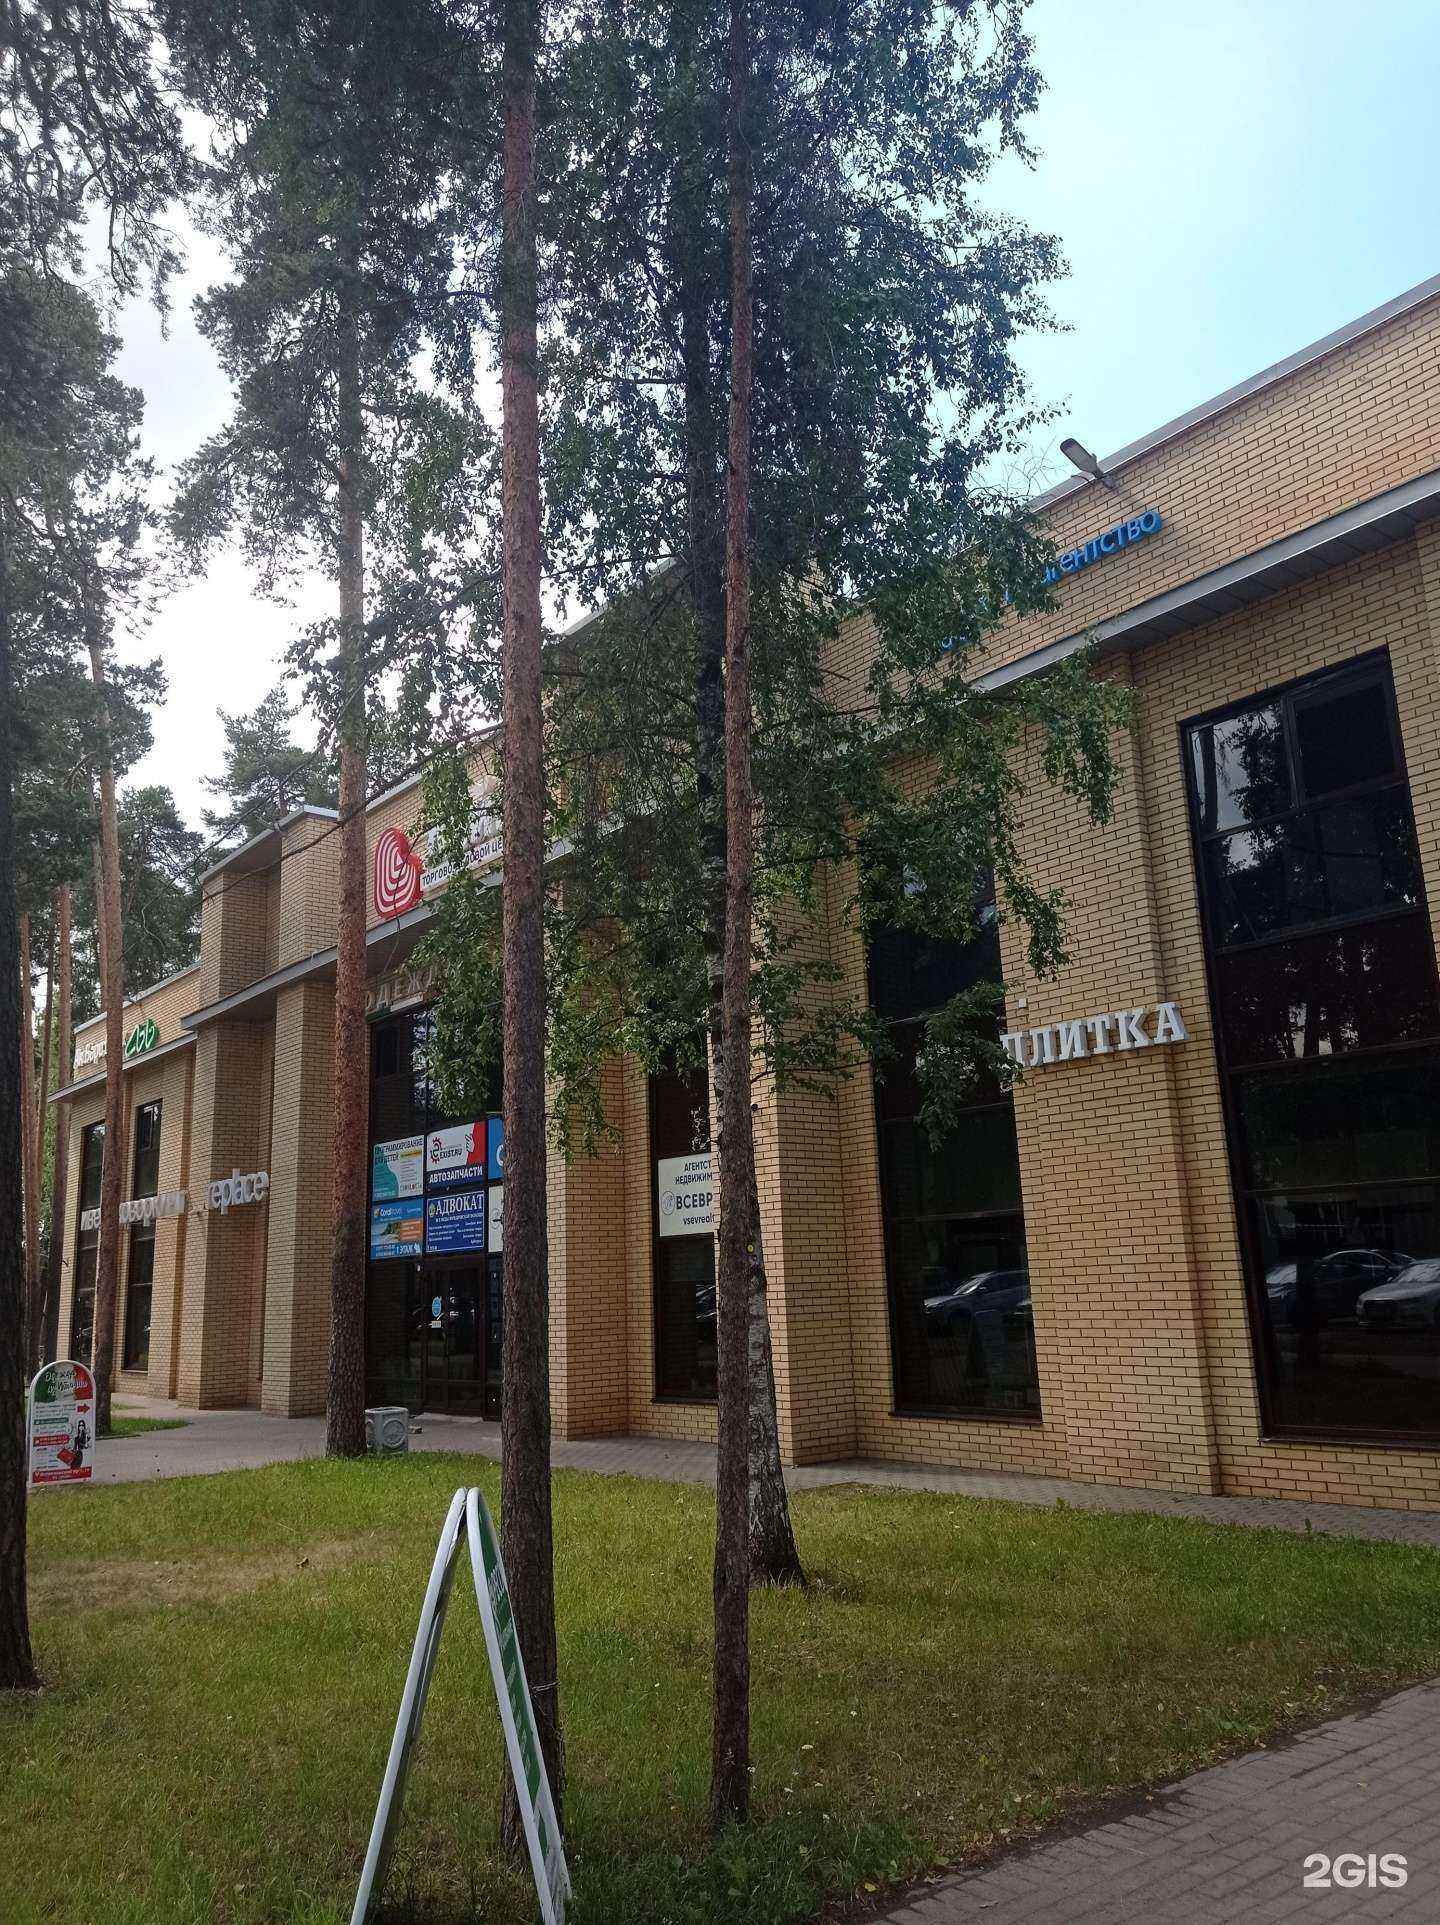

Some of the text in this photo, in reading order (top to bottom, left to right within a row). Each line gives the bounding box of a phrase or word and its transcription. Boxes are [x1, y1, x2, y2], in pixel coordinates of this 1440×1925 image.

[1000, 1002, 1188, 1067] ПЛИТКА
[429, 1166, 483, 1184] АВТОЗАПЧАСТИ
[436, 1194, 484, 1216] АДВОКАТ
